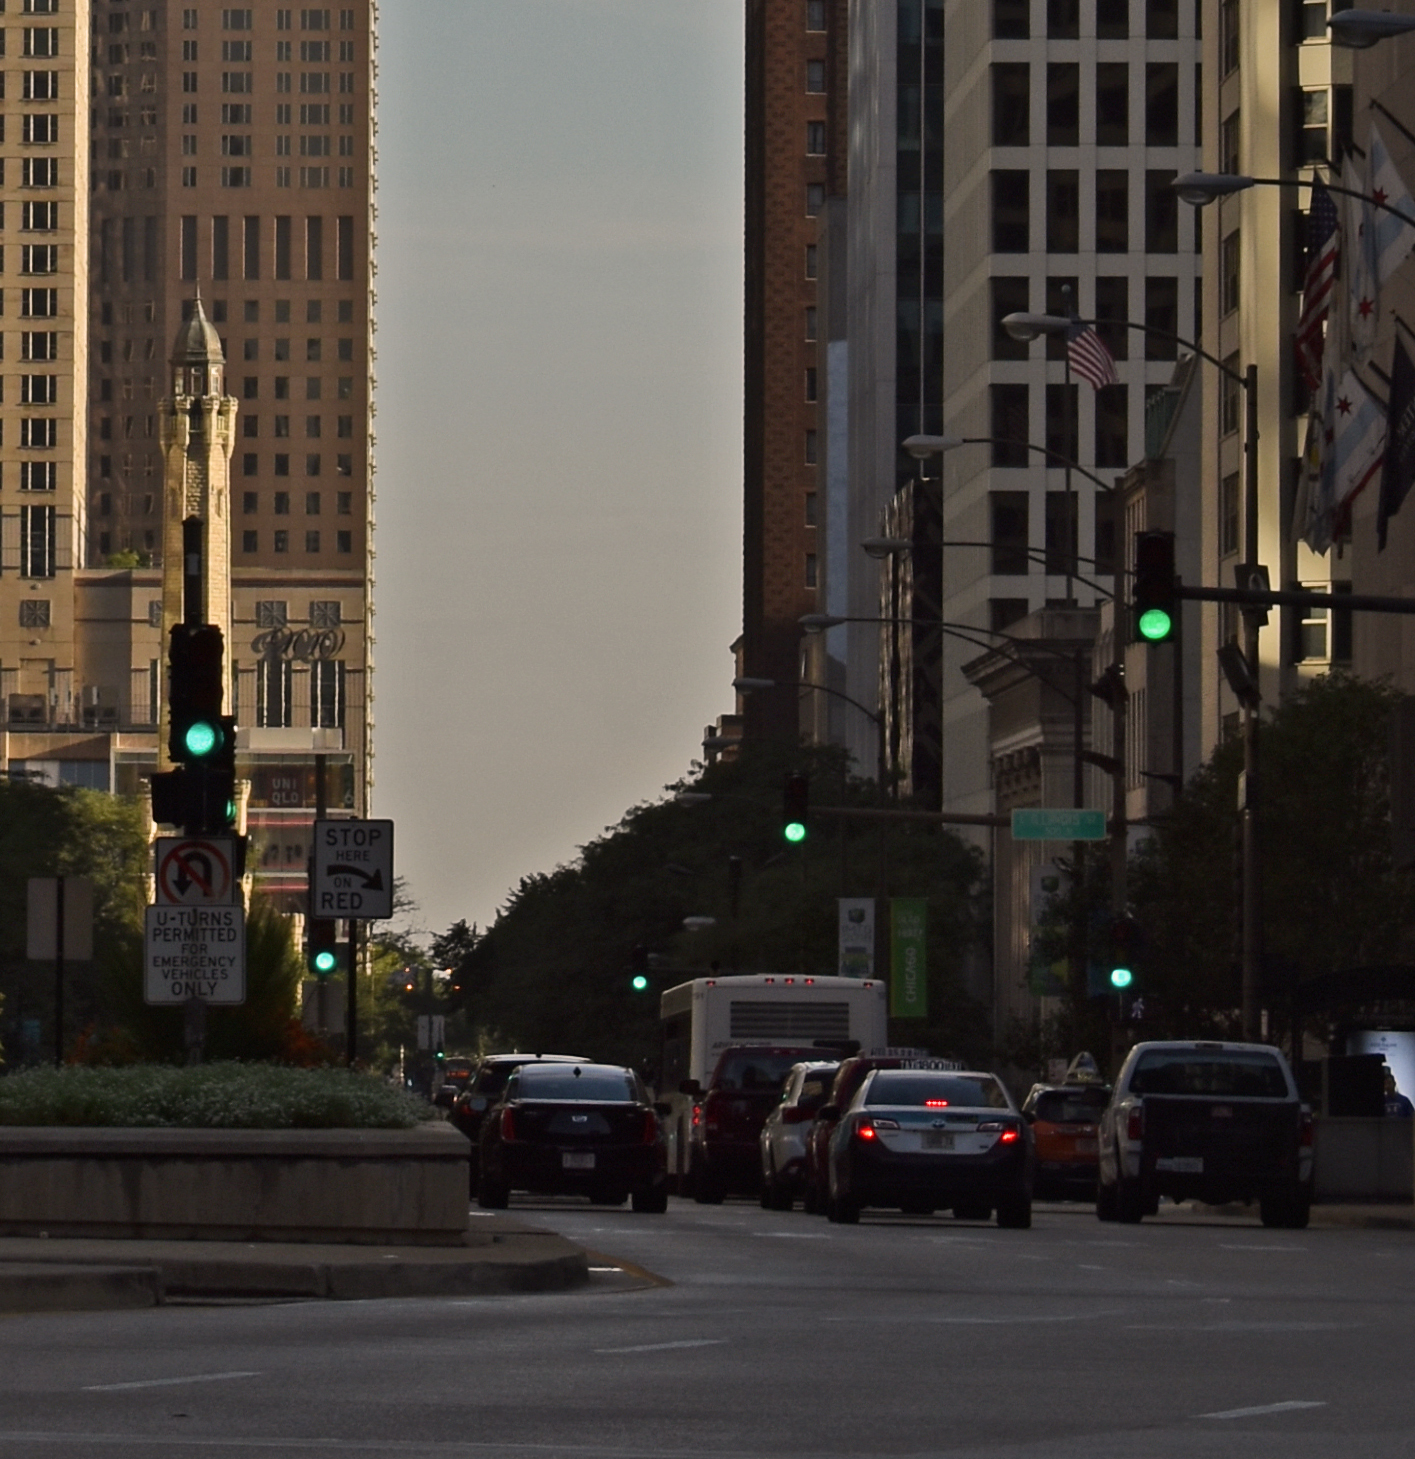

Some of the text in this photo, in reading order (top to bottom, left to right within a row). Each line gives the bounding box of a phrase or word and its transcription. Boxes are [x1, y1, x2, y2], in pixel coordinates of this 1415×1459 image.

[272, 778, 297, 789] UNI
[272, 792, 298, 805] QLO
[326, 828, 382, 847] STOP
[336, 850, 370, 862] HERE
[334, 877, 351, 888] ON
[322, 892, 363, 910] RED
[157, 912, 233, 926] U-TURNS
[153, 928, 237, 942] PERMITTED
[181, 944, 208, 954] FOR
[153, 956, 236, 967] EMERGENCY
[162, 969, 229, 980] VEHICLES
[172, 982, 218, 997] ONLY
